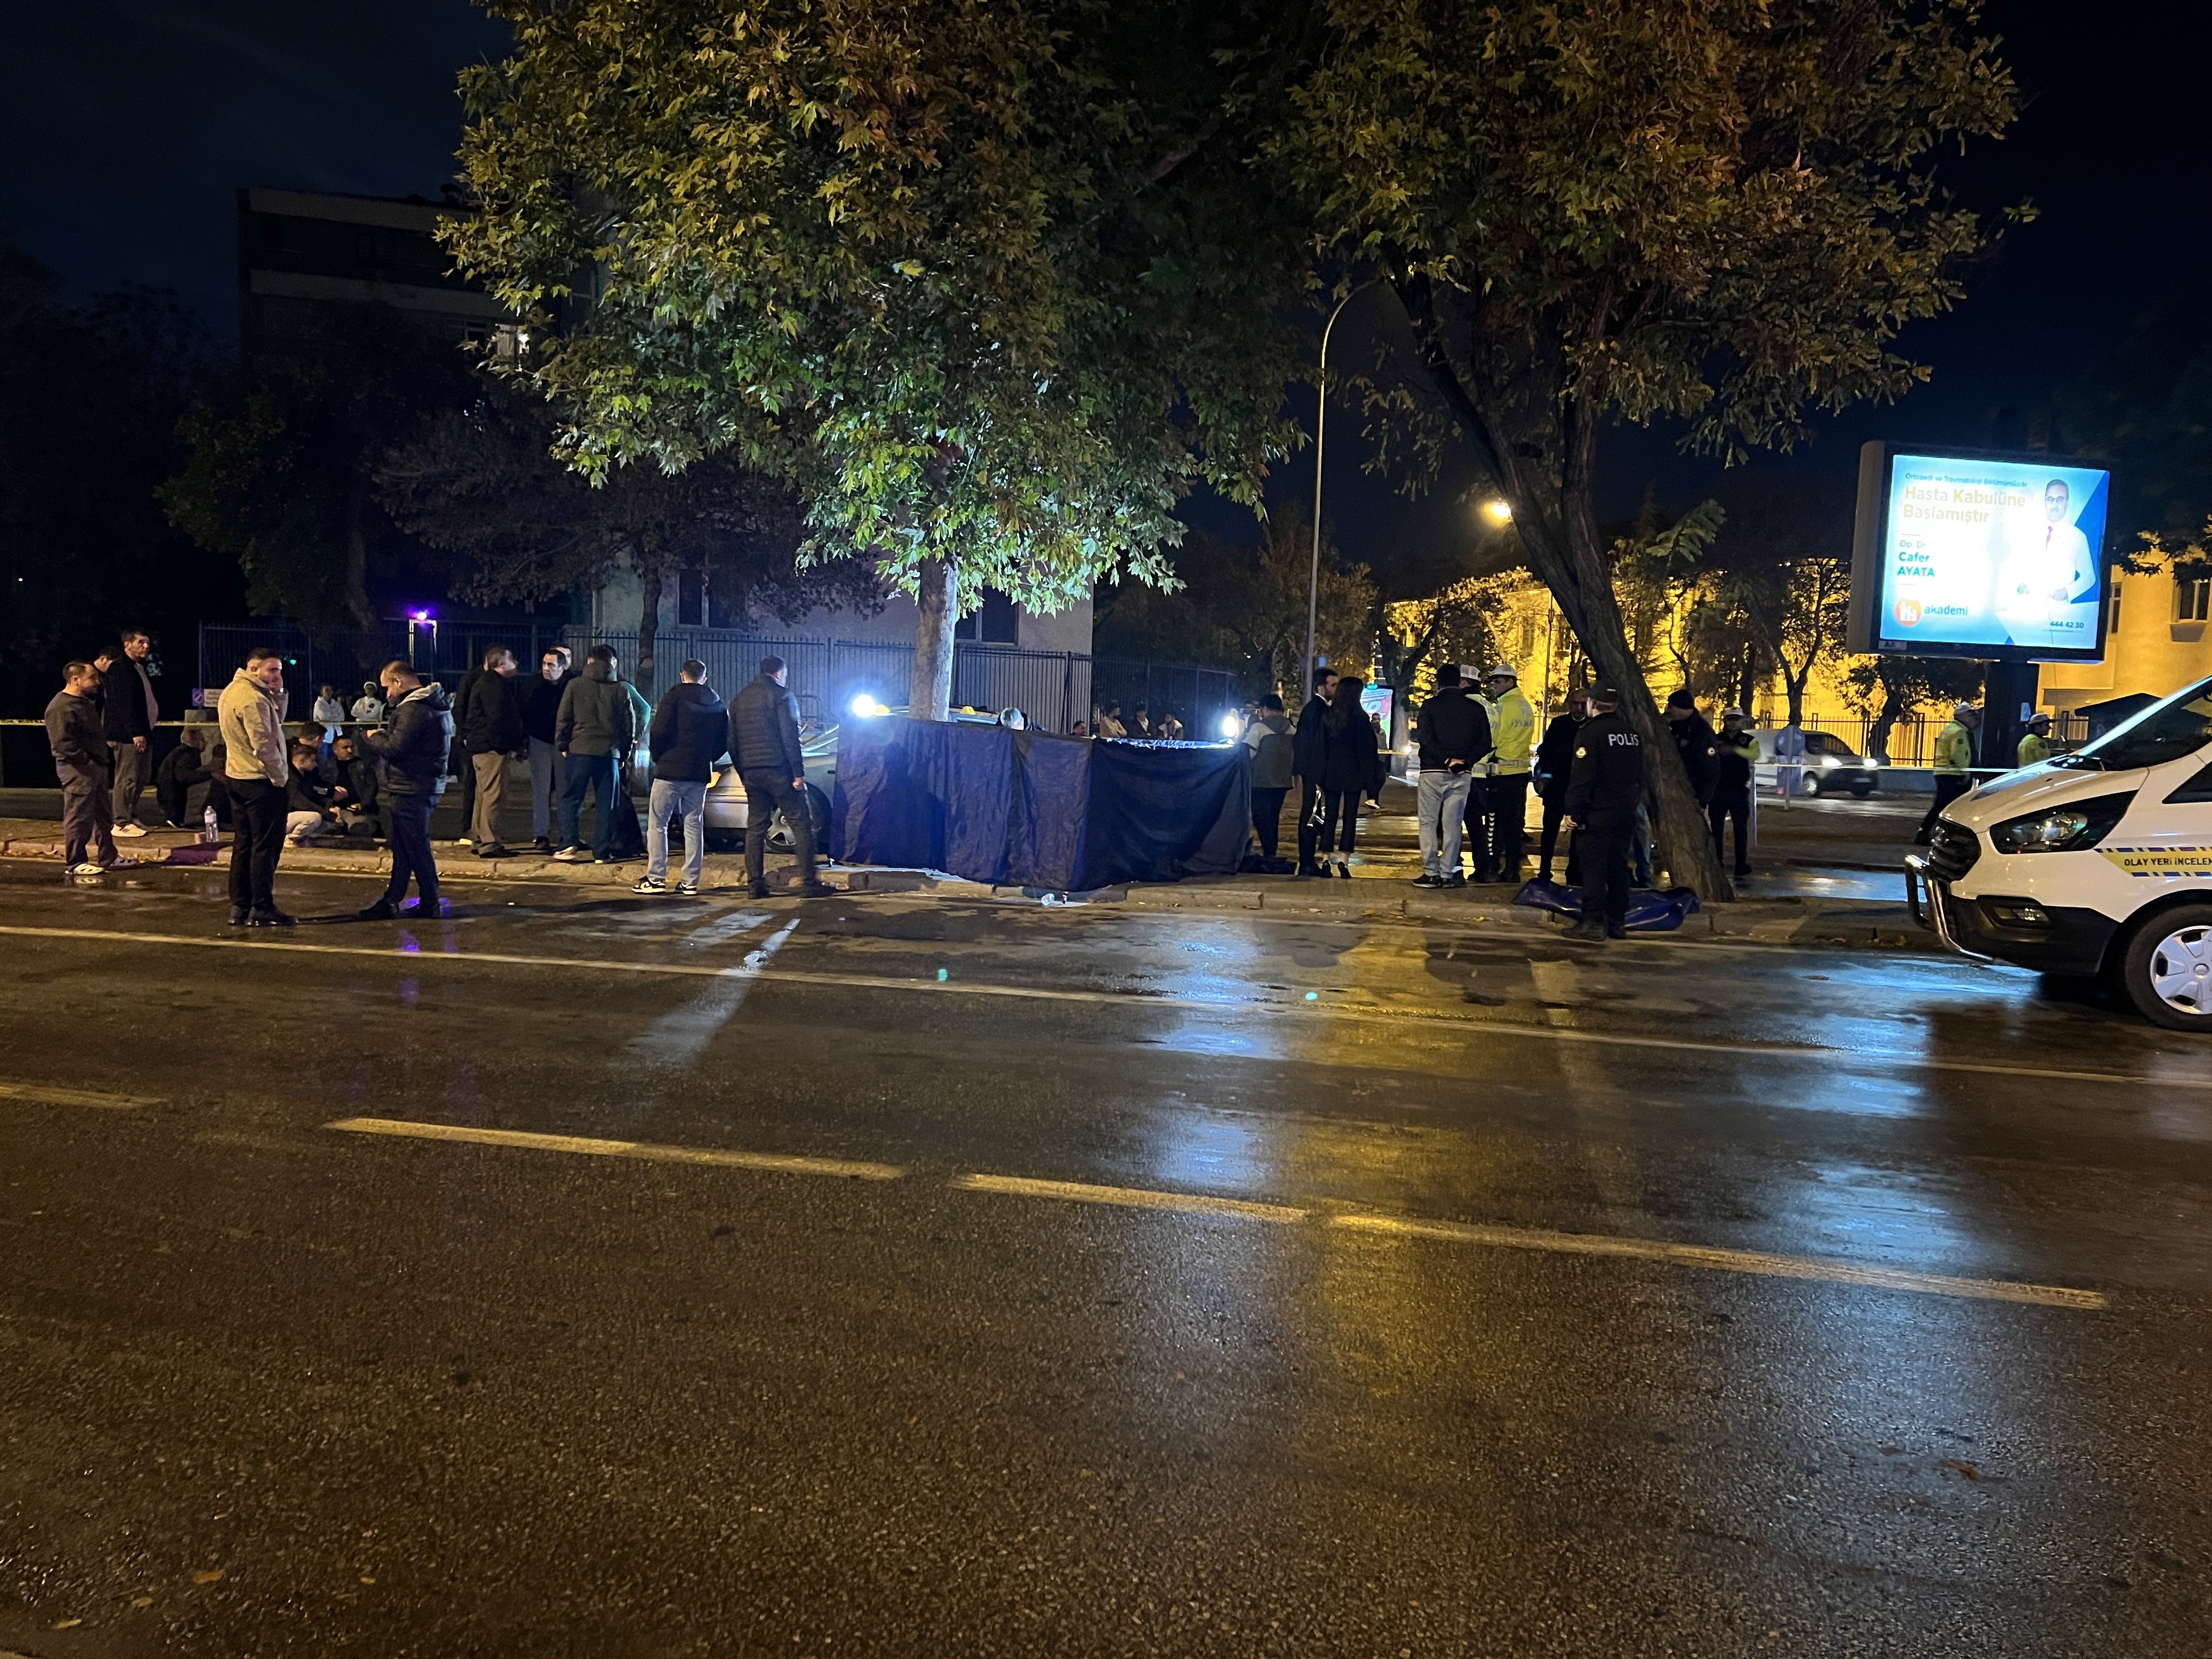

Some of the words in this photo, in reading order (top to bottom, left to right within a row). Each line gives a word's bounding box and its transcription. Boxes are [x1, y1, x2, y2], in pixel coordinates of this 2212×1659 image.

[1905, 486, 1948, 501] Hasta
[1954, 489, 2025, 506] Kabulüne
[1903, 504, 1989, 523] Başlamıştır
[1899, 551, 1930, 562] Cafer
[1897, 566, 1934, 577] AYATA
[1925, 605, 1968, 616] akademi
